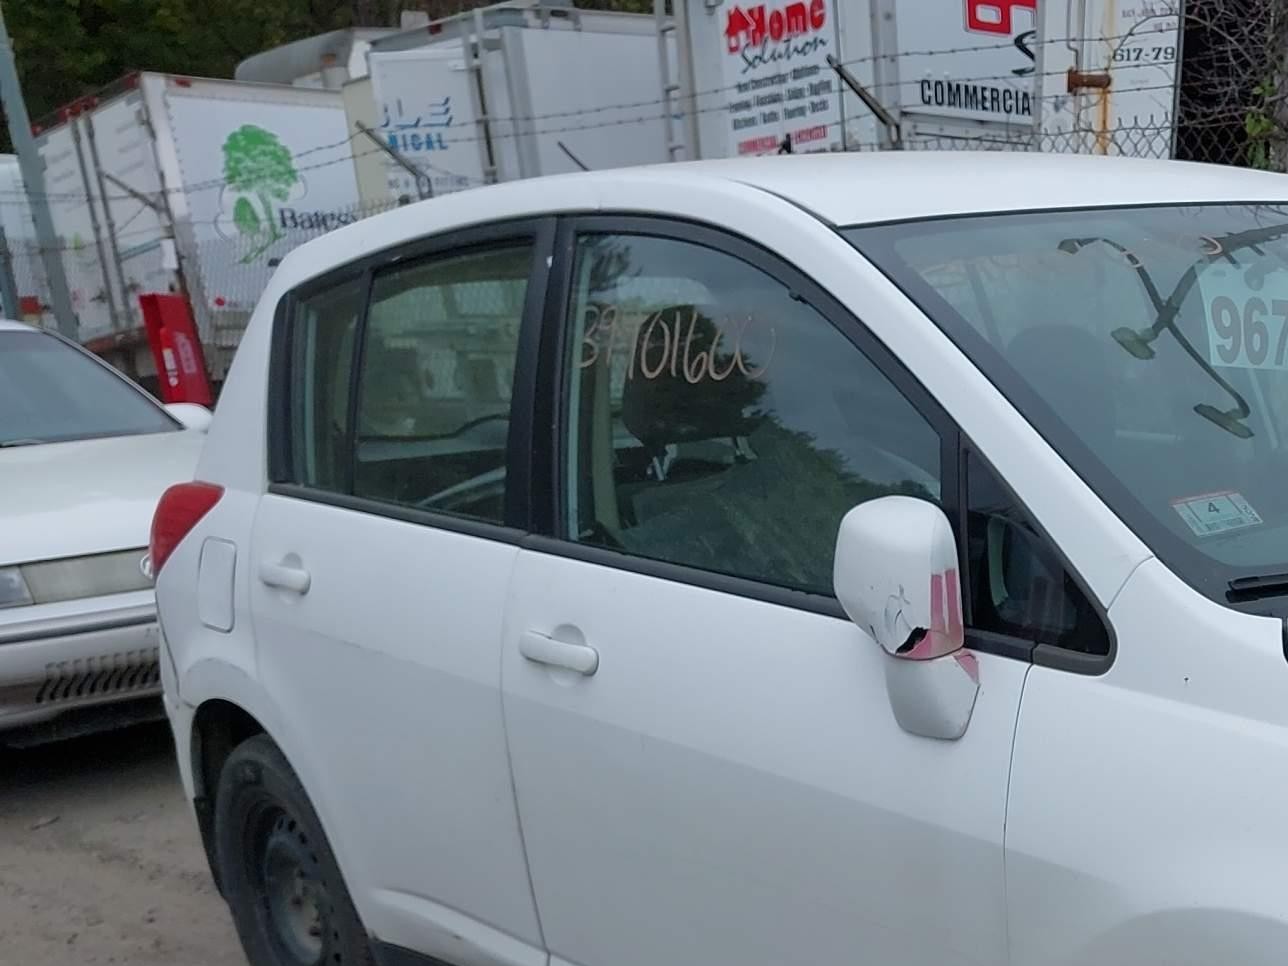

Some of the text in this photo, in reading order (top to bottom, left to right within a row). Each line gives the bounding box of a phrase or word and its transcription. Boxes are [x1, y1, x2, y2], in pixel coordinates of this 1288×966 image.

[738, 0, 826, 48] Home
[741, 36, 828, 74] Solution
[1208, 502, 1220, 513] 4
